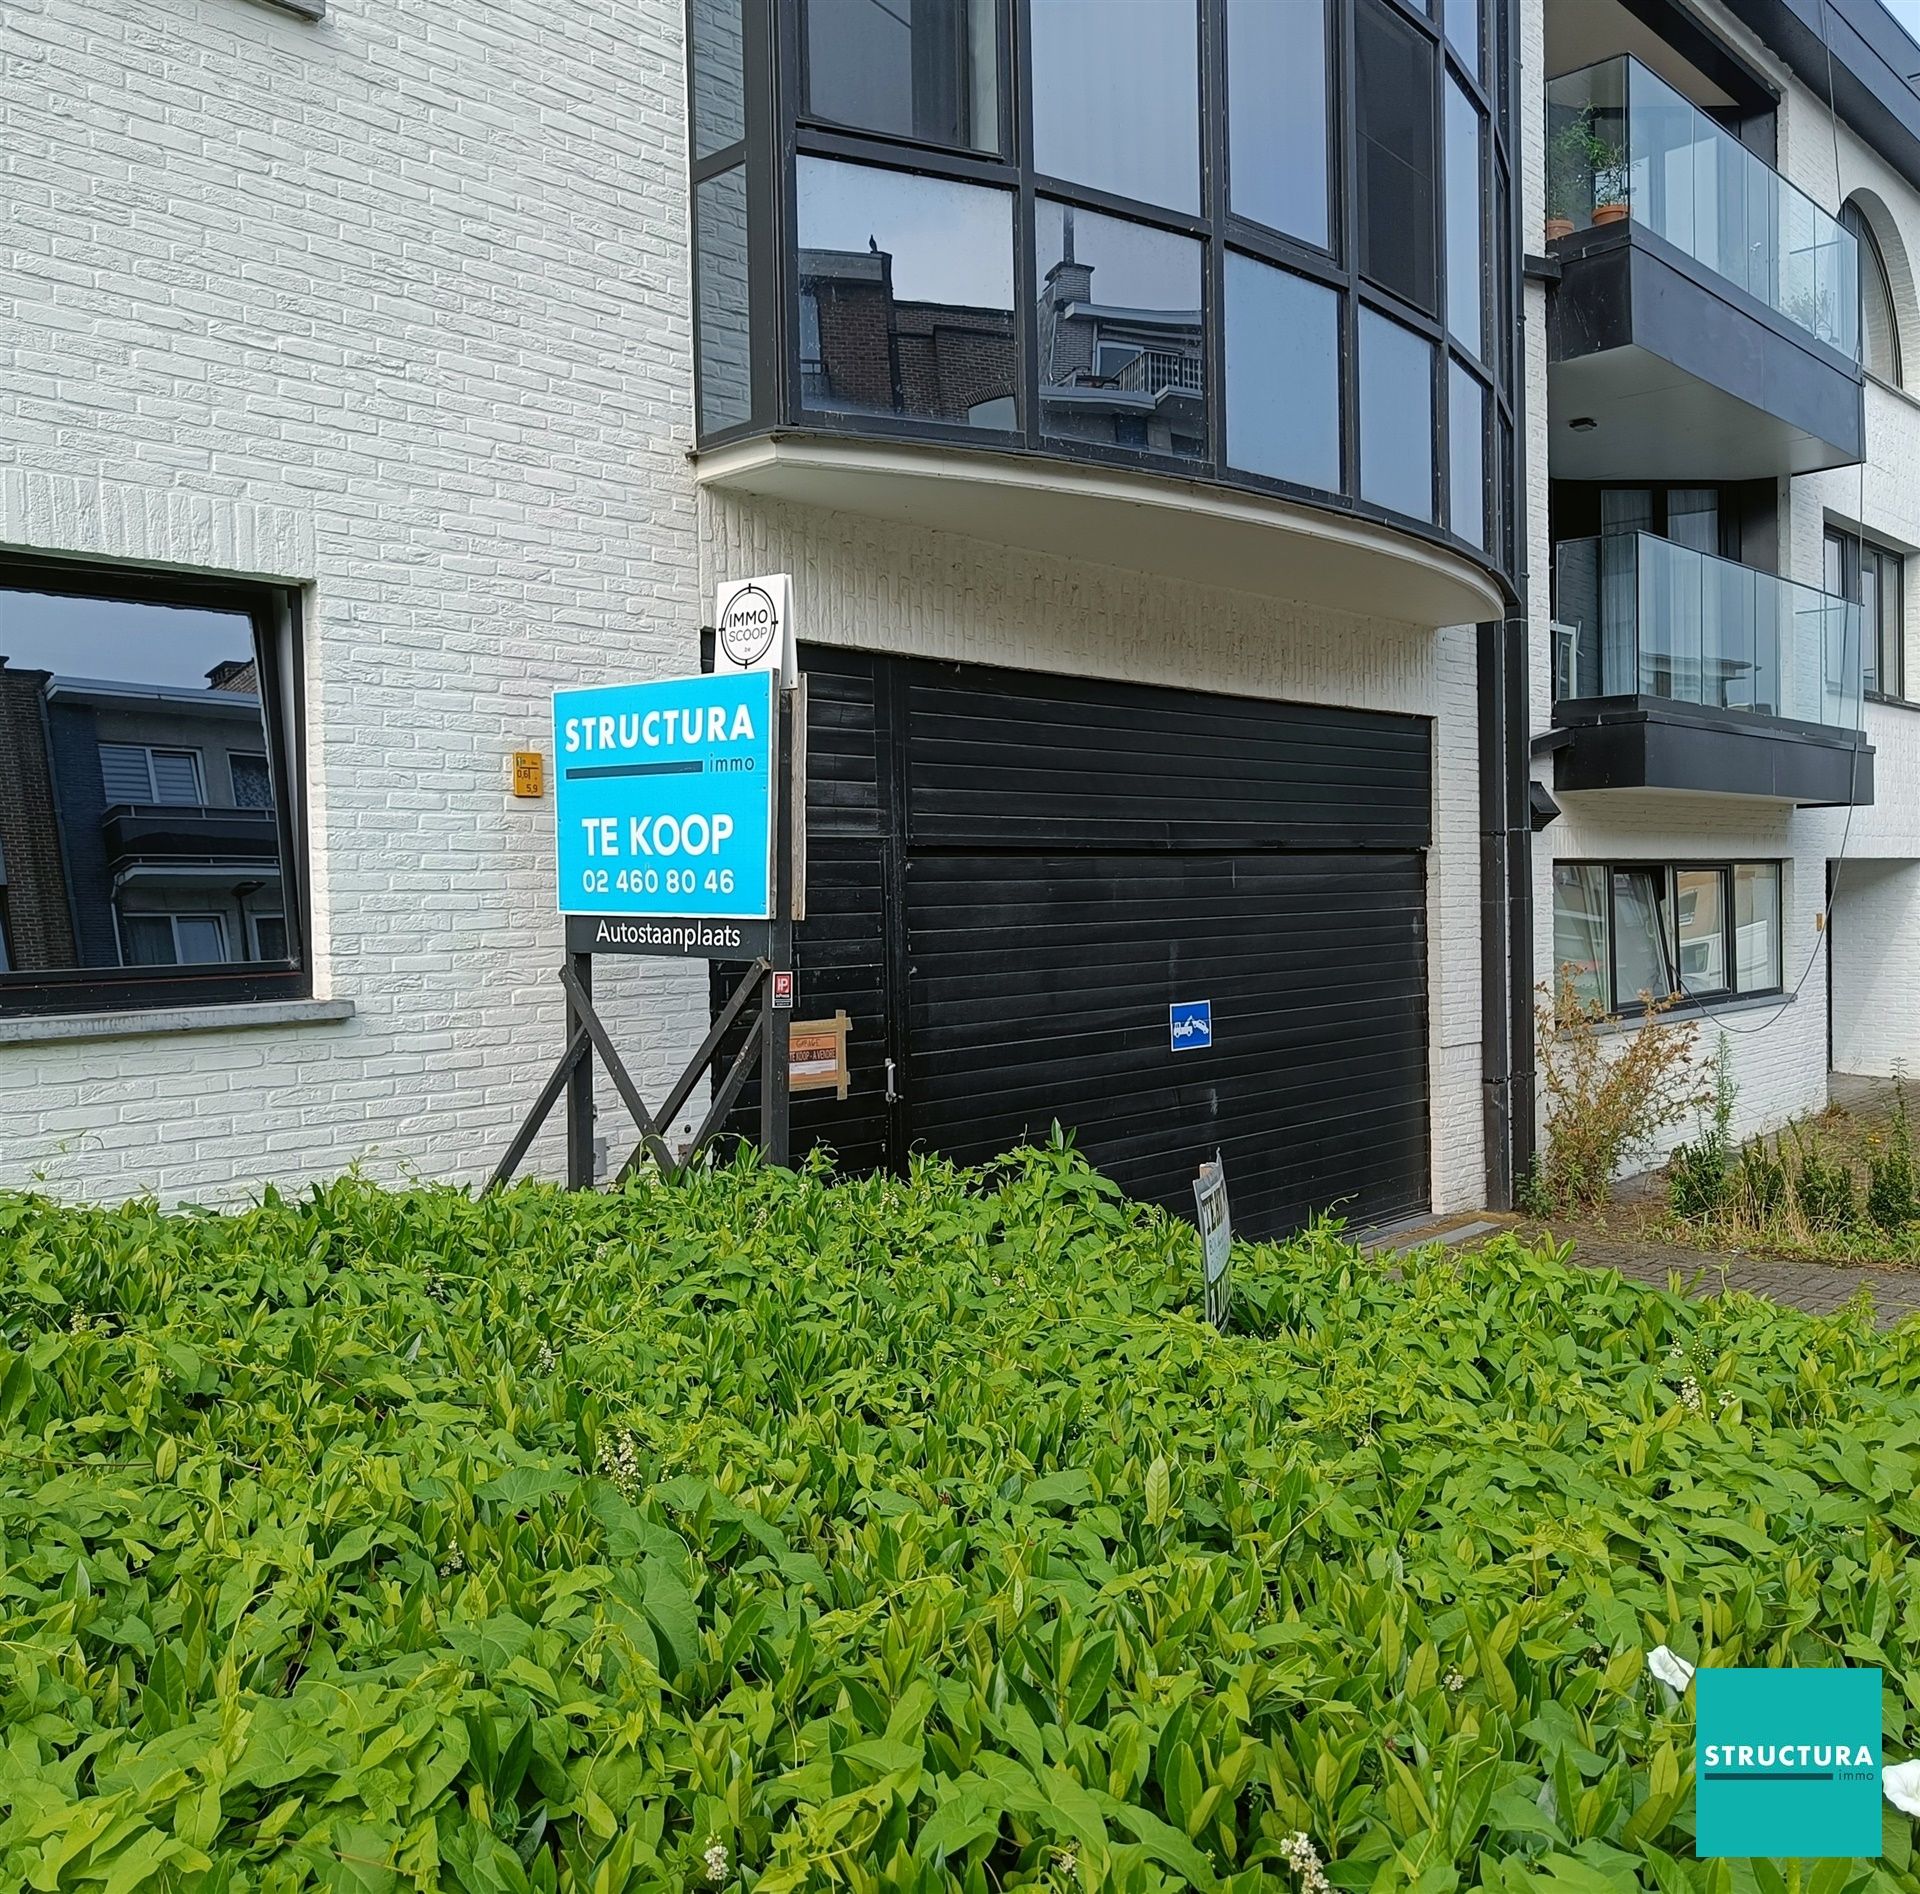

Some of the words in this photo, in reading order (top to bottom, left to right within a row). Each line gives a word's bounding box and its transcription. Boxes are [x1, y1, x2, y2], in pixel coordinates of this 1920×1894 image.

[729, 609, 768, 628] IMMO
[728, 626, 768, 643] SCOOP
[564, 703, 755, 753] STRUCTURA
[709, 753, 755, 773] immo
[581, 817, 620, 857] TE
[629, 813, 734, 857] KOOP
[582, 869, 609, 893] 02
[616, 869, 659, 894] 460
[666, 869, 696, 893] 80
[703, 869, 735, 893] 46
[596, 919, 742, 953] Autostaanplaats
[796, 1050, 810, 1061] KOOP
